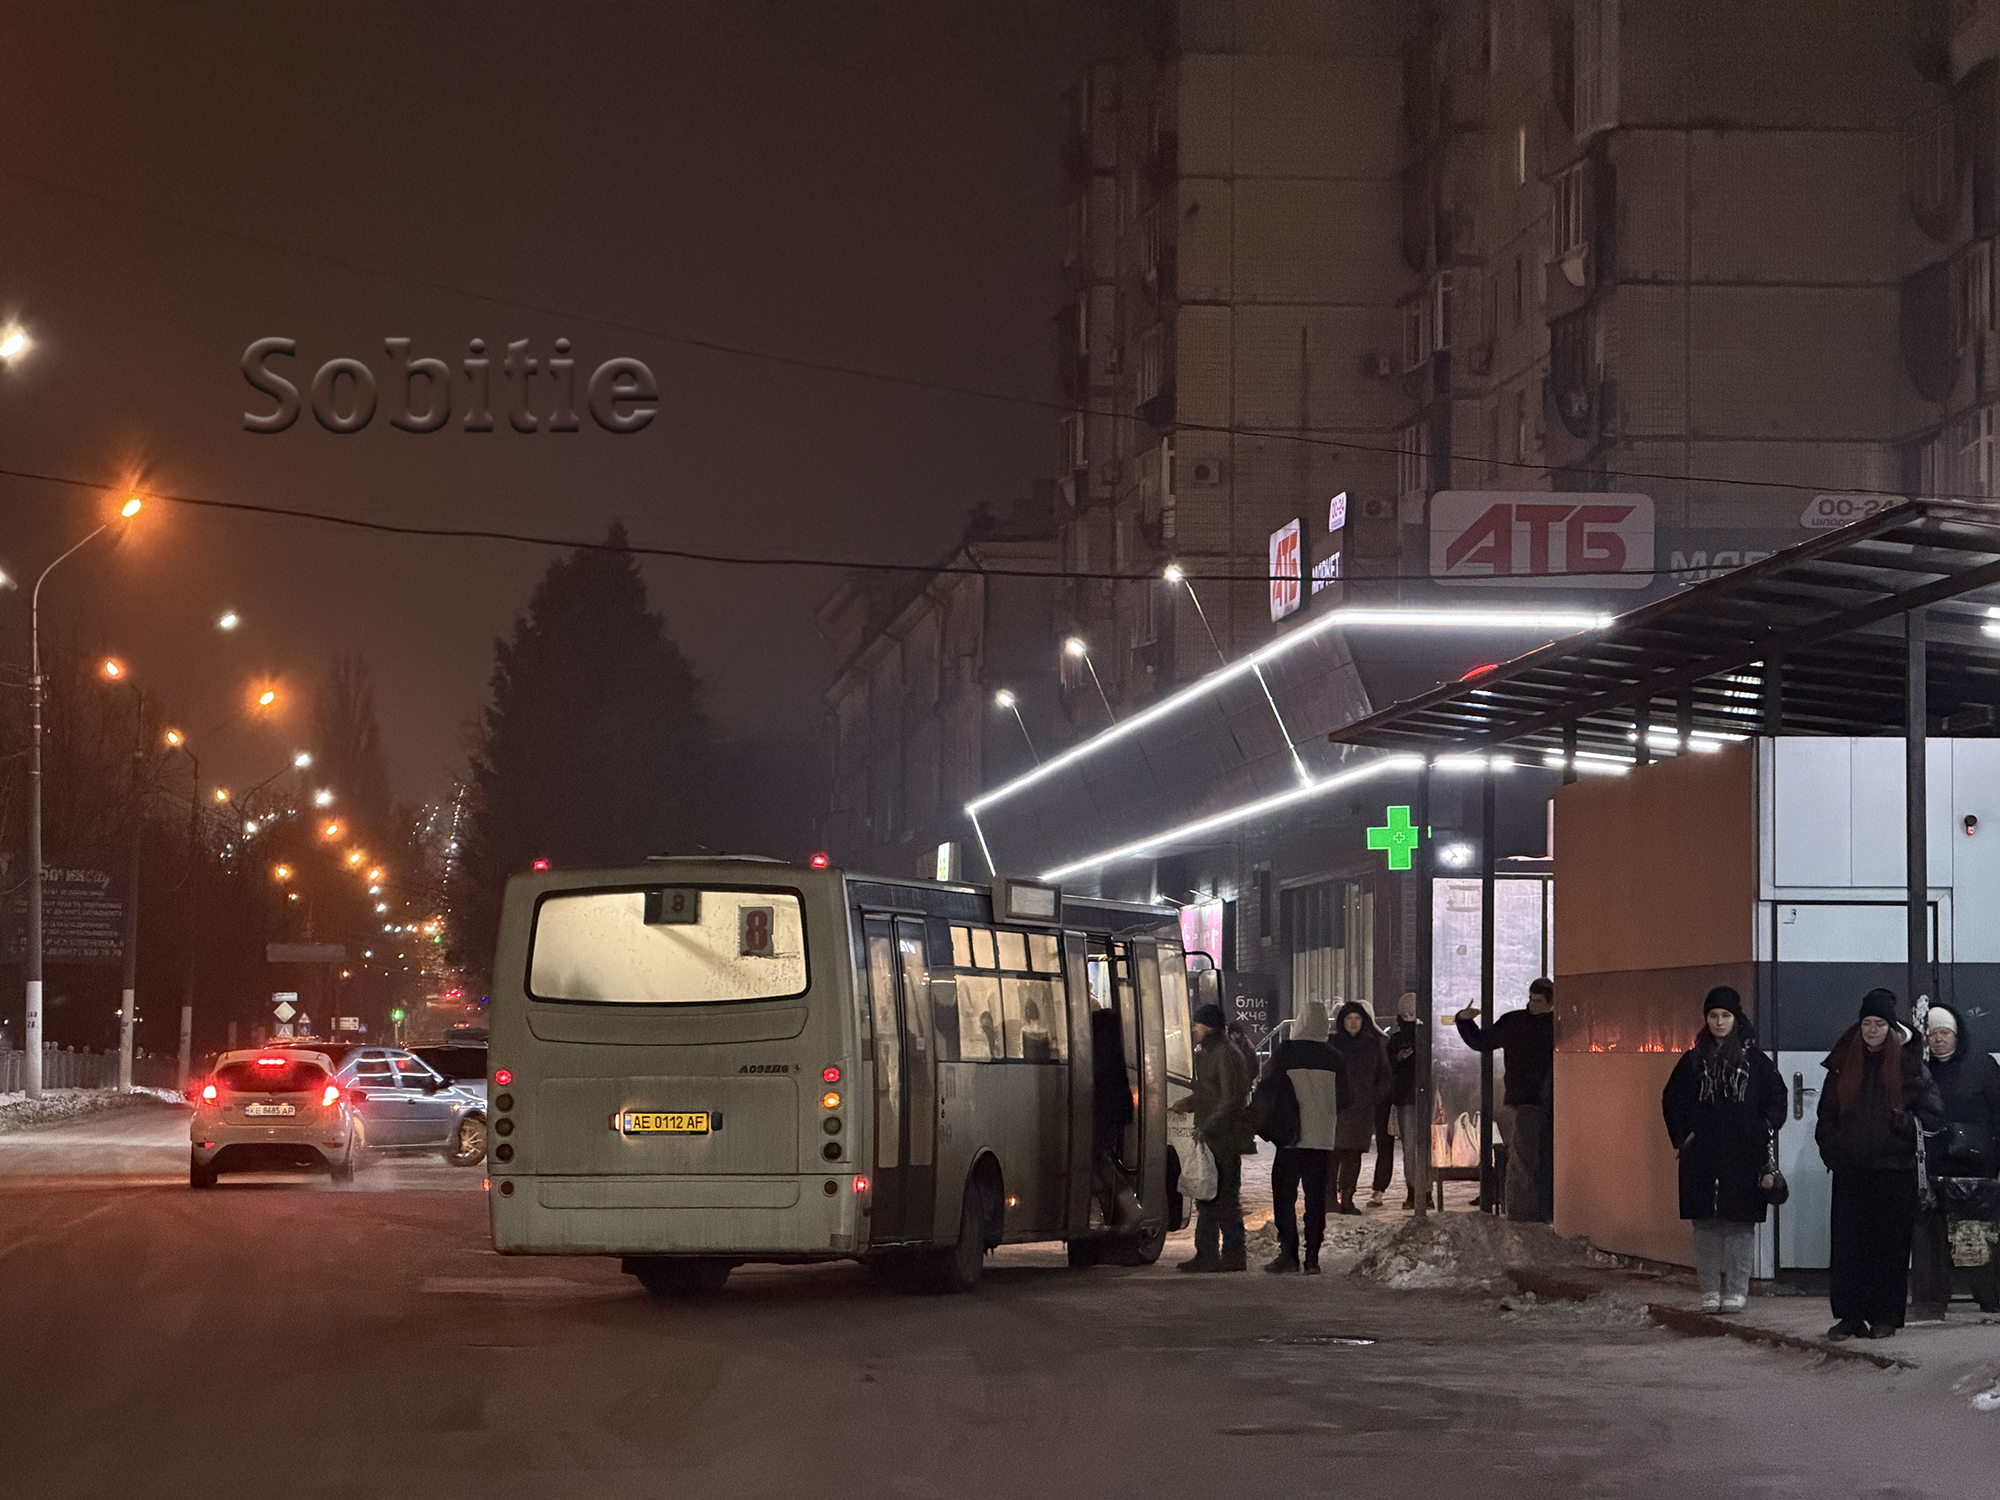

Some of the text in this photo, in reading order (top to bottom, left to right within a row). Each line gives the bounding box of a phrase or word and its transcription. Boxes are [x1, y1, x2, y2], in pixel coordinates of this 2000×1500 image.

[1446, 504, 1637, 574] АТБ
[1272, 530, 1298, 607] АТБ
[671, 894, 686, 914] 8
[745, 909, 769, 952] 8
[1236, 1011, 1267, 1021] жче
[633, 1116, 704, 1129] AE 0112 AF
